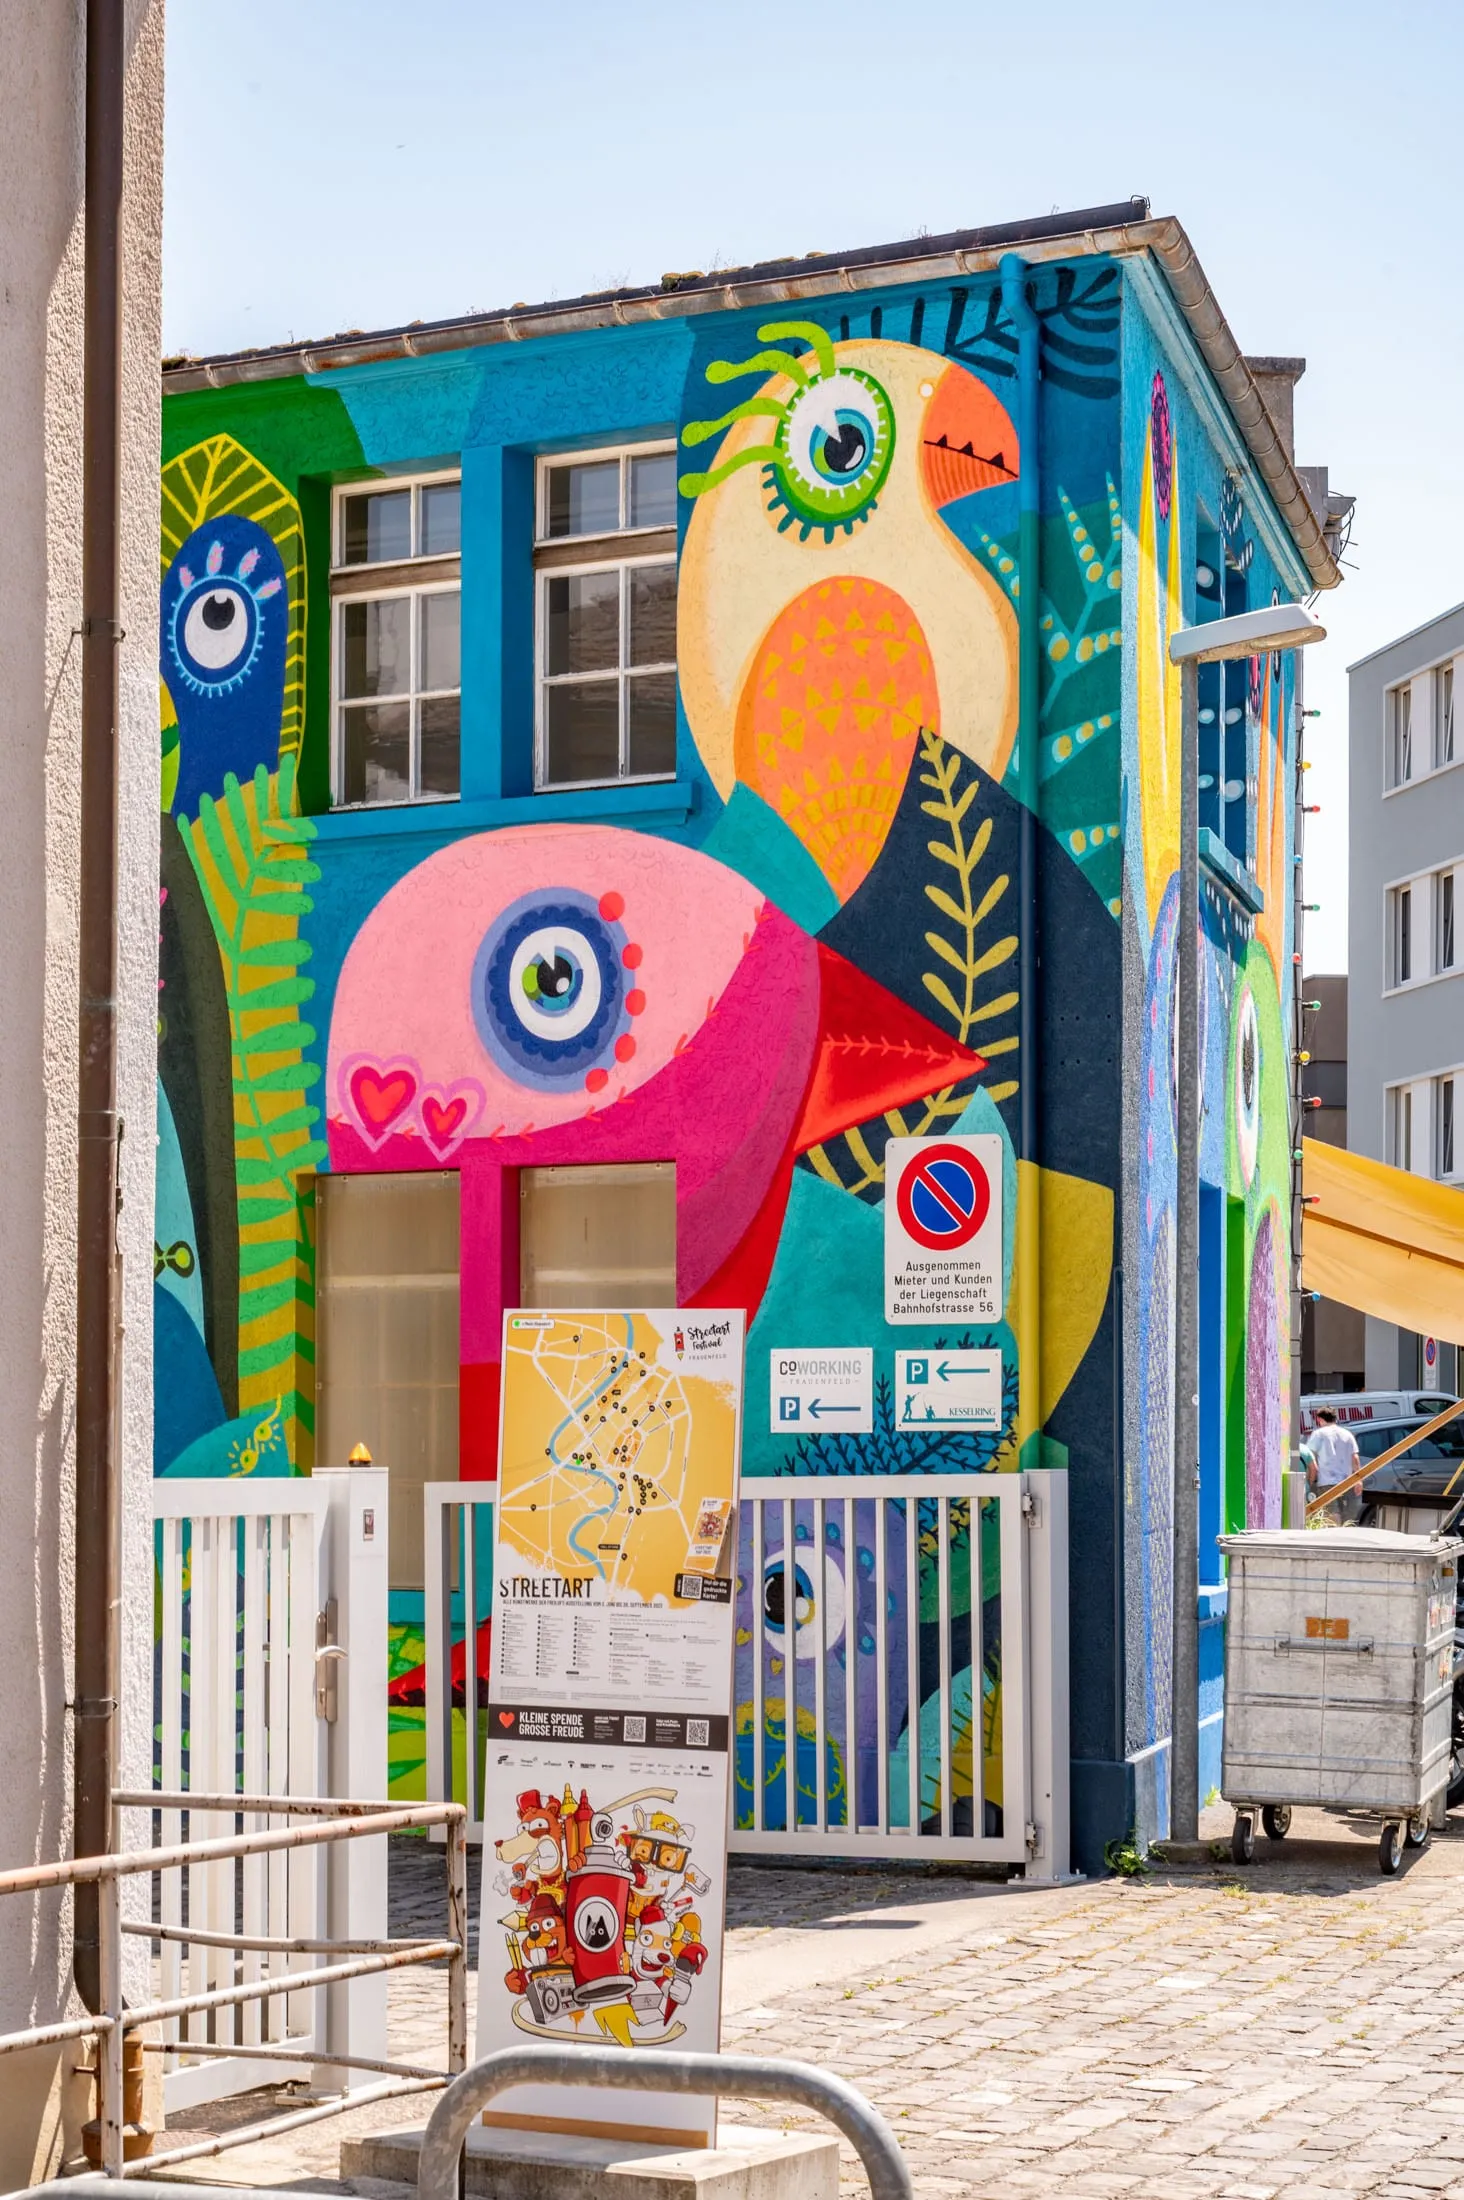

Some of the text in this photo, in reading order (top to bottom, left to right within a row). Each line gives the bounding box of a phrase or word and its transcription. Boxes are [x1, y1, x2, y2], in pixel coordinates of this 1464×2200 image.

[905, 1261, 981, 1273] Ausgenommen
[894, 1273, 993, 1286] Mieter und Kunden
[899, 1288, 987, 1302] der Liegenschaft
[893, 1301, 994, 1314] Bahnhofstrasse 56
[687, 1320, 731, 1340] Streetart
[692, 1337, 722, 1350] Festival
[911, 1361, 924, 1381] P
[789, 1377, 851, 1385] FRAUENFELD
[784, 1399, 797, 1418] P
[949, 1407, 996, 1417] KESSELRING
[499, 1577, 594, 1599] STREETART
[519, 1711, 583, 1726] KLEINE SPENDE
[518, 1723, 551, 1736] GROSSE
[552, 1725, 585, 1738] FREUDE
